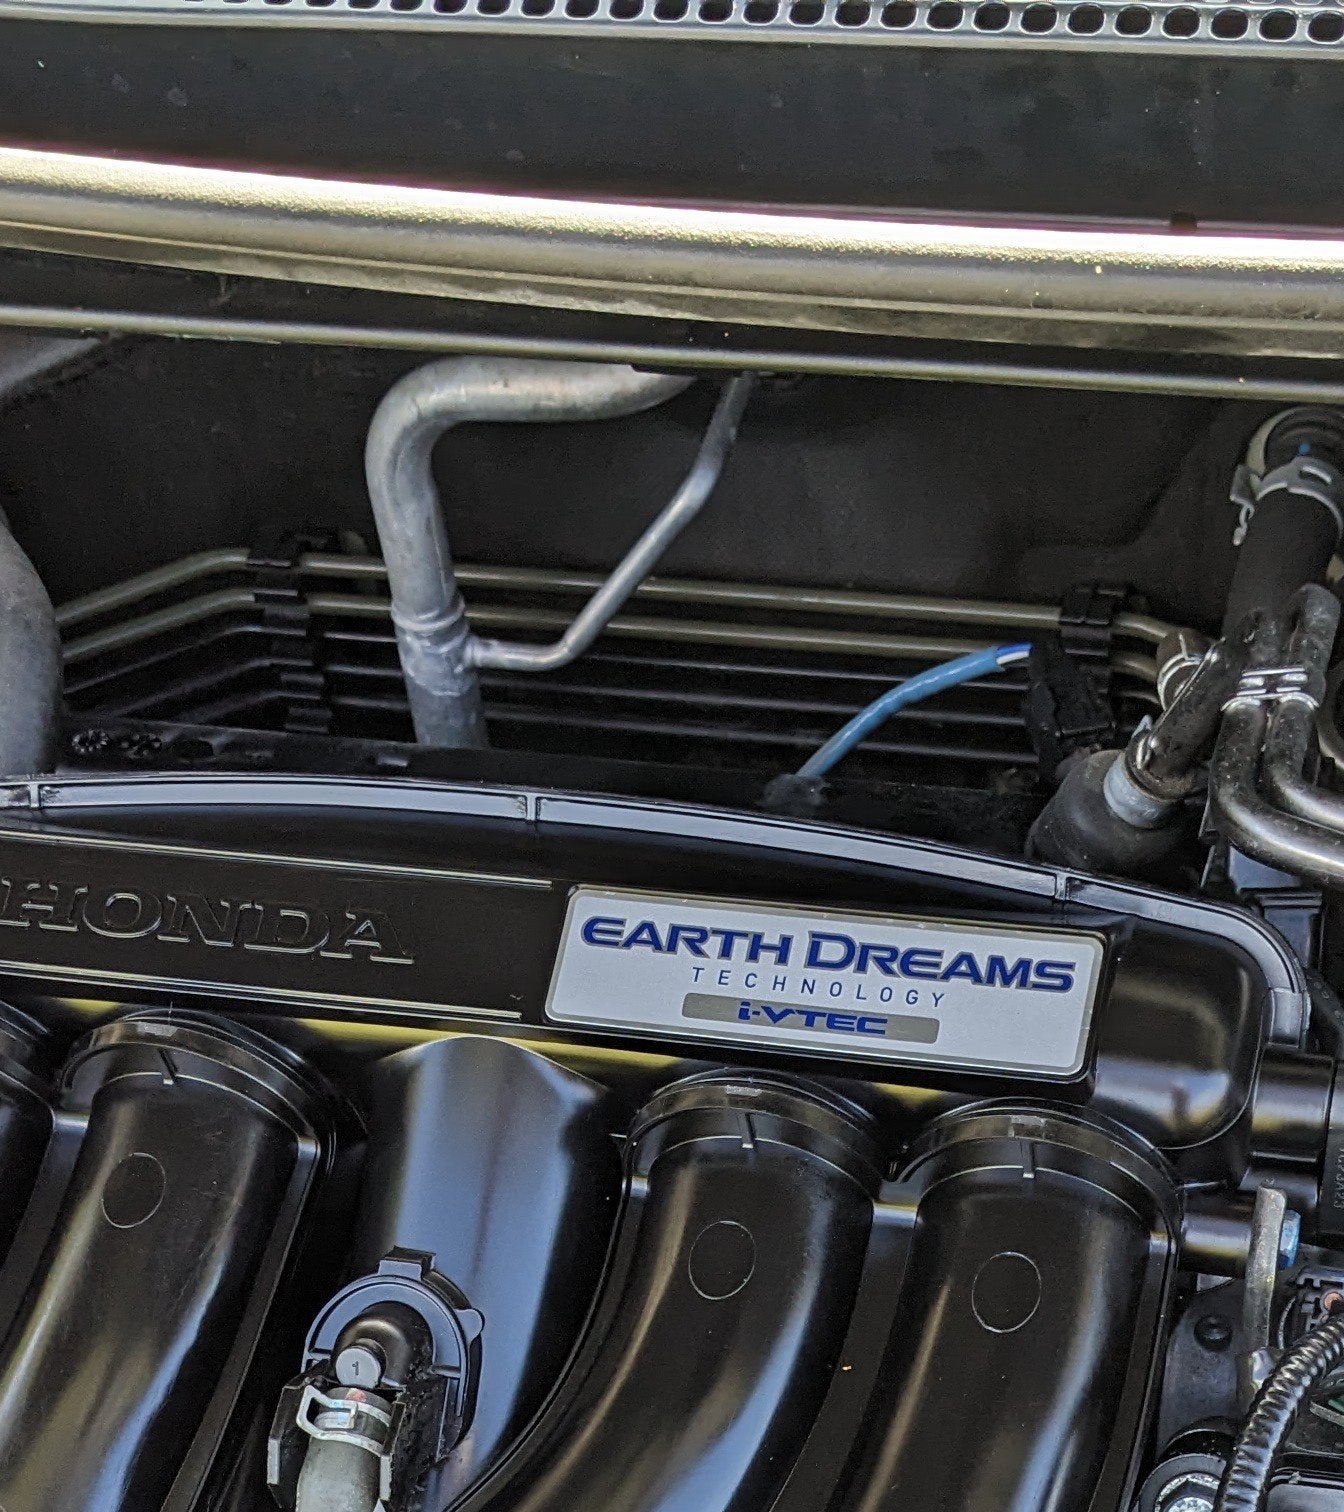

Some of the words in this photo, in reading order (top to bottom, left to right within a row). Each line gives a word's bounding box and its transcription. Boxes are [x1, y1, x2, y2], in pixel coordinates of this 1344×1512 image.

[581, 915, 794, 966] EARTH
[804, 930, 1077, 994] DREAMS
[692, 966, 945, 1008] TECHNOLOGY
[738, 1001, 888, 1036] i-VTEC
